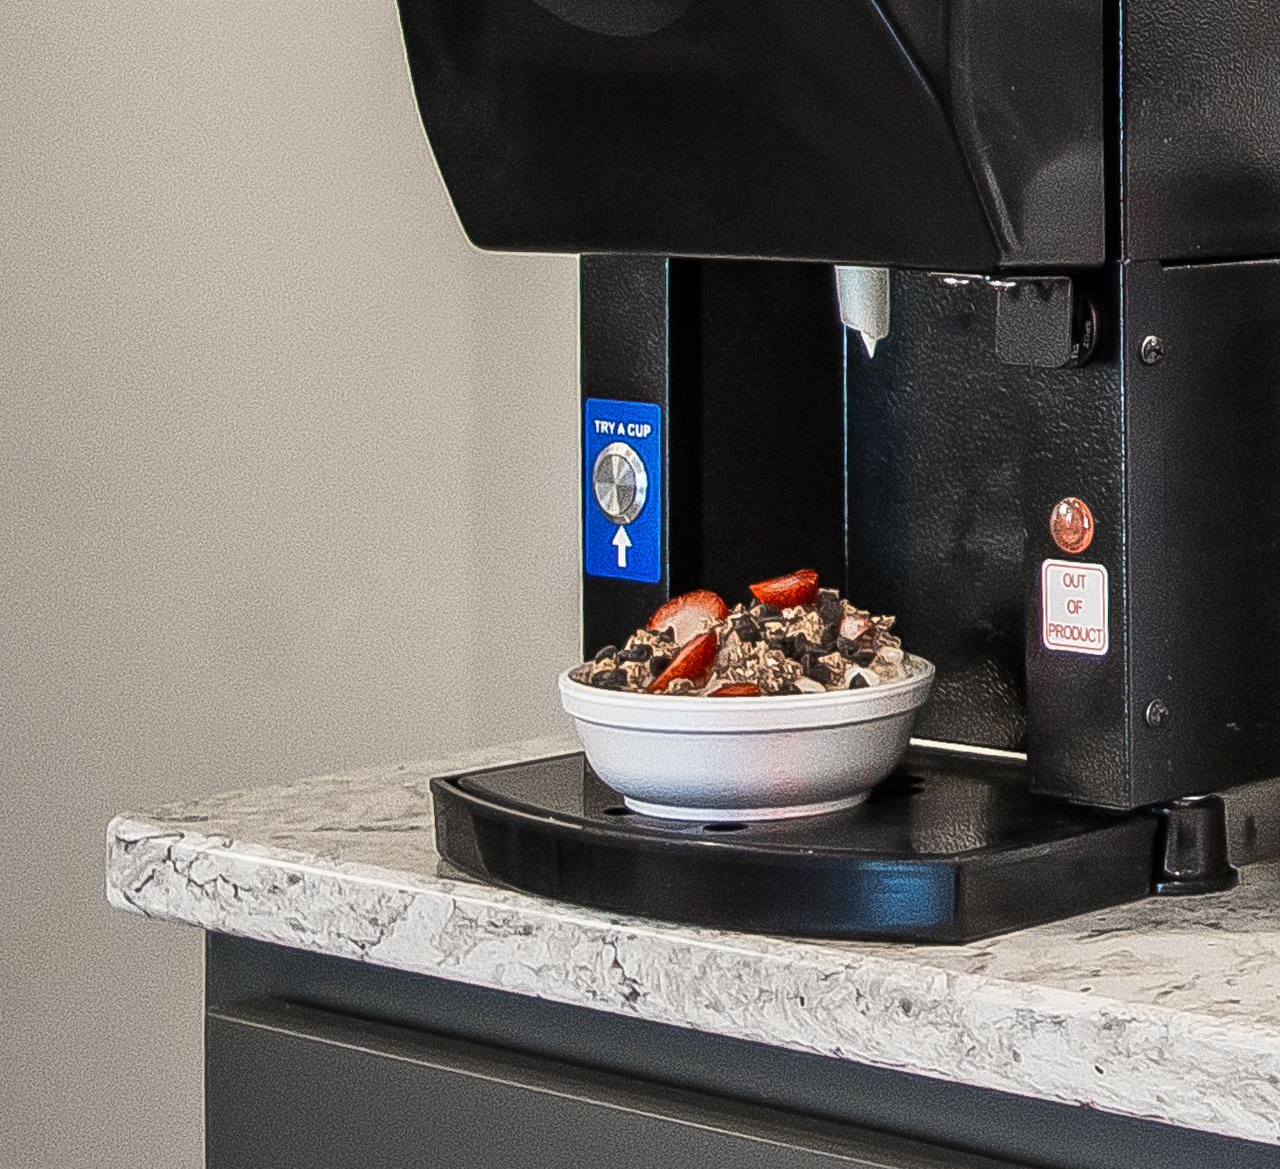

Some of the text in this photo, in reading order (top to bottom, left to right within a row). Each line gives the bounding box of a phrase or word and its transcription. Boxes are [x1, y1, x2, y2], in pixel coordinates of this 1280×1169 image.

[594, 419, 652, 438] TRY A CUP
[1062, 572, 1087, 590] OUT
[1066, 599, 1084, 615] OF
[1048, 623, 1104, 645] PRODUCT
